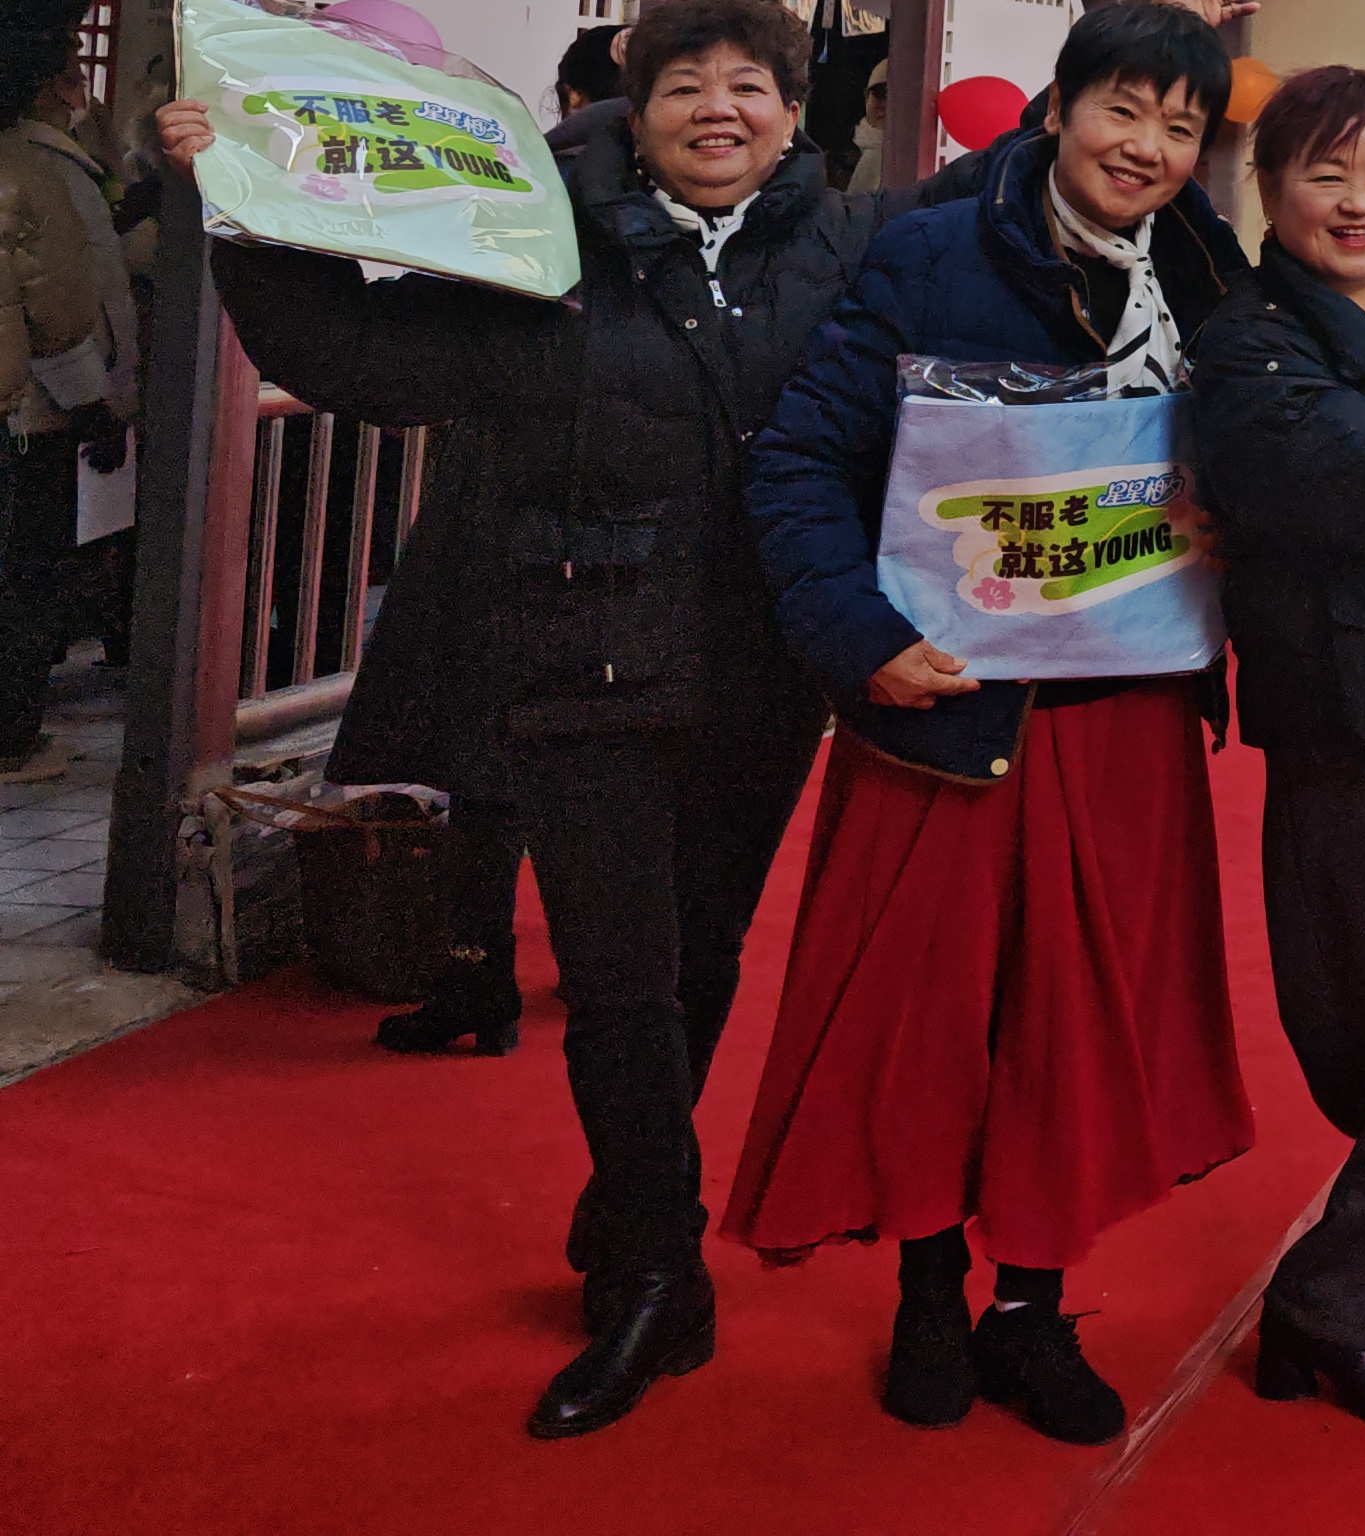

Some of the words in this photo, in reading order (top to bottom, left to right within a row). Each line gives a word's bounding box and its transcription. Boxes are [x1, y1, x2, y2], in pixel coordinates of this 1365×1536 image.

[293, 96, 410, 126] 不服老
[981, 495, 1089, 532] 不服老
